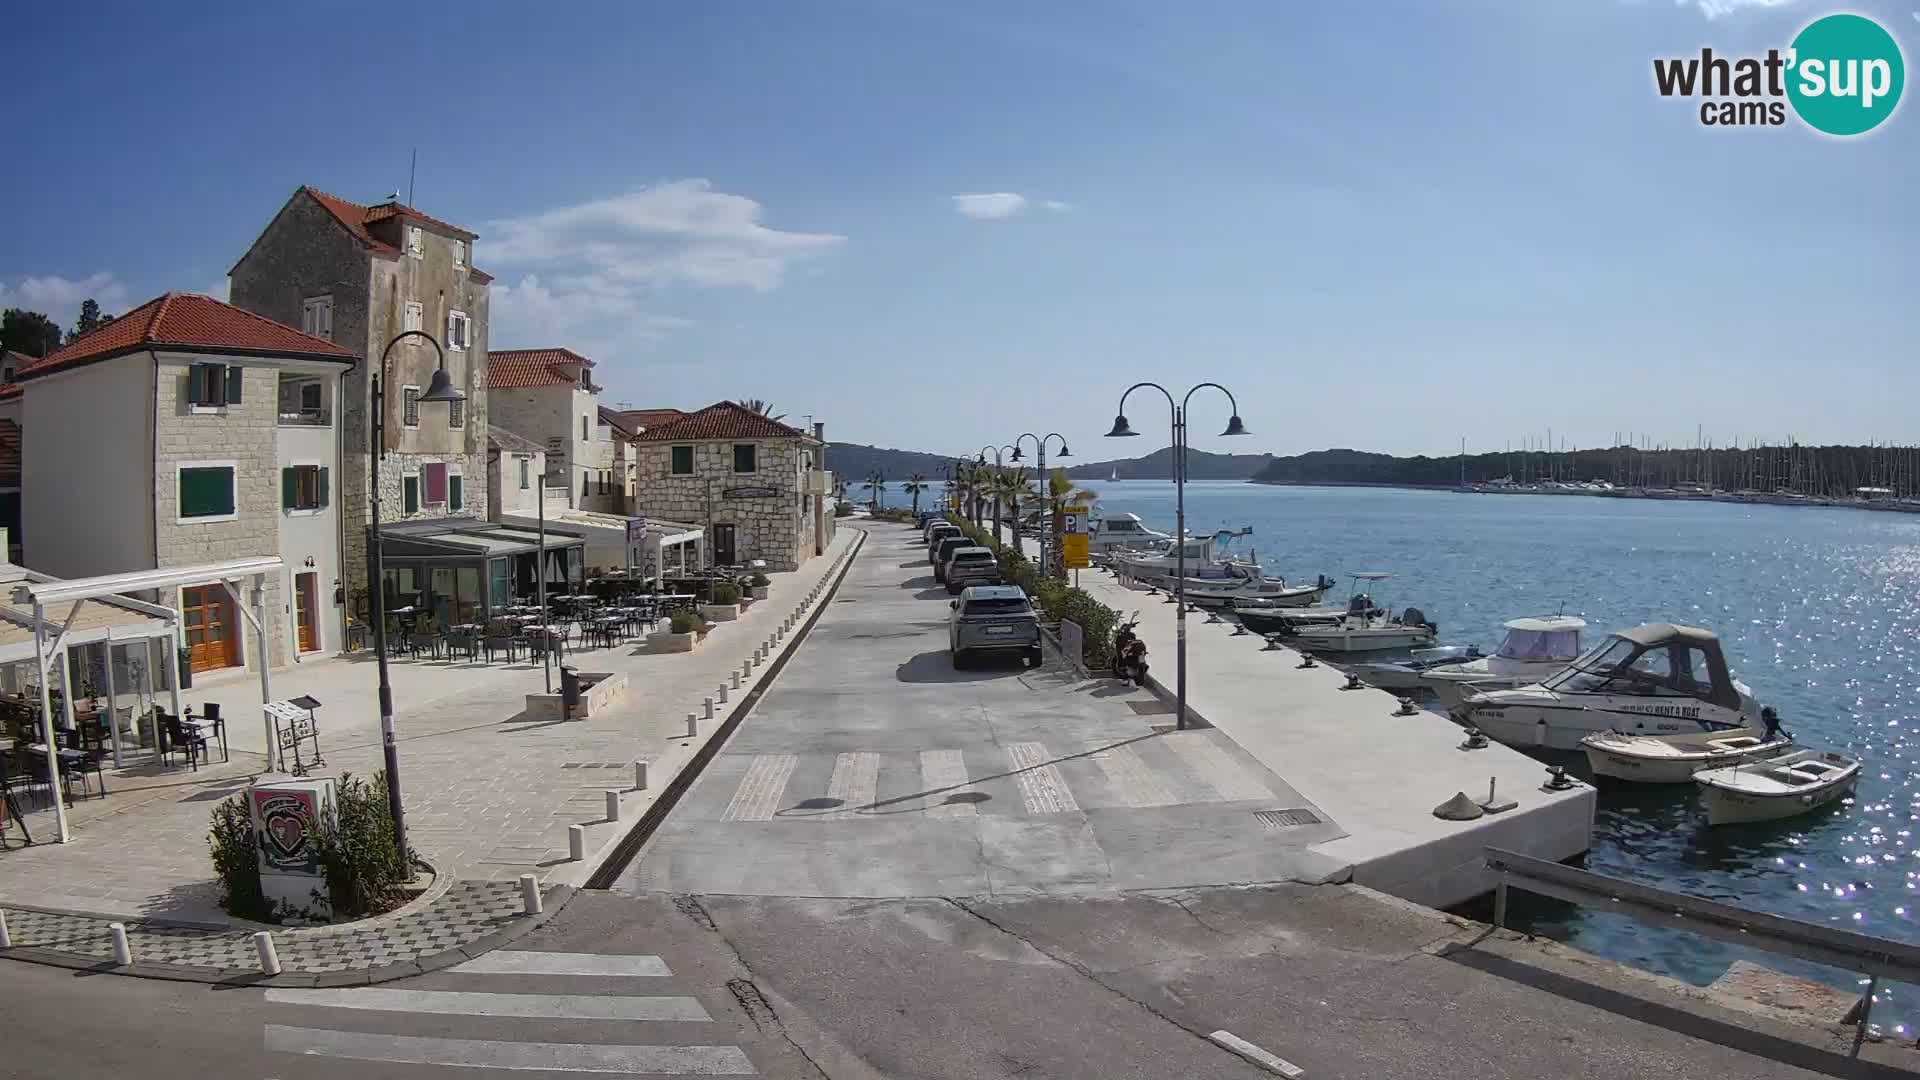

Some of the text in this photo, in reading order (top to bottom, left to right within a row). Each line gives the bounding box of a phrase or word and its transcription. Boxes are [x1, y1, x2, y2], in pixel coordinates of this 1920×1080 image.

[1065, 515, 1076, 531] P
[1654, 705, 1674, 716] RENT
[1682, 706, 1700, 718] BOAT
